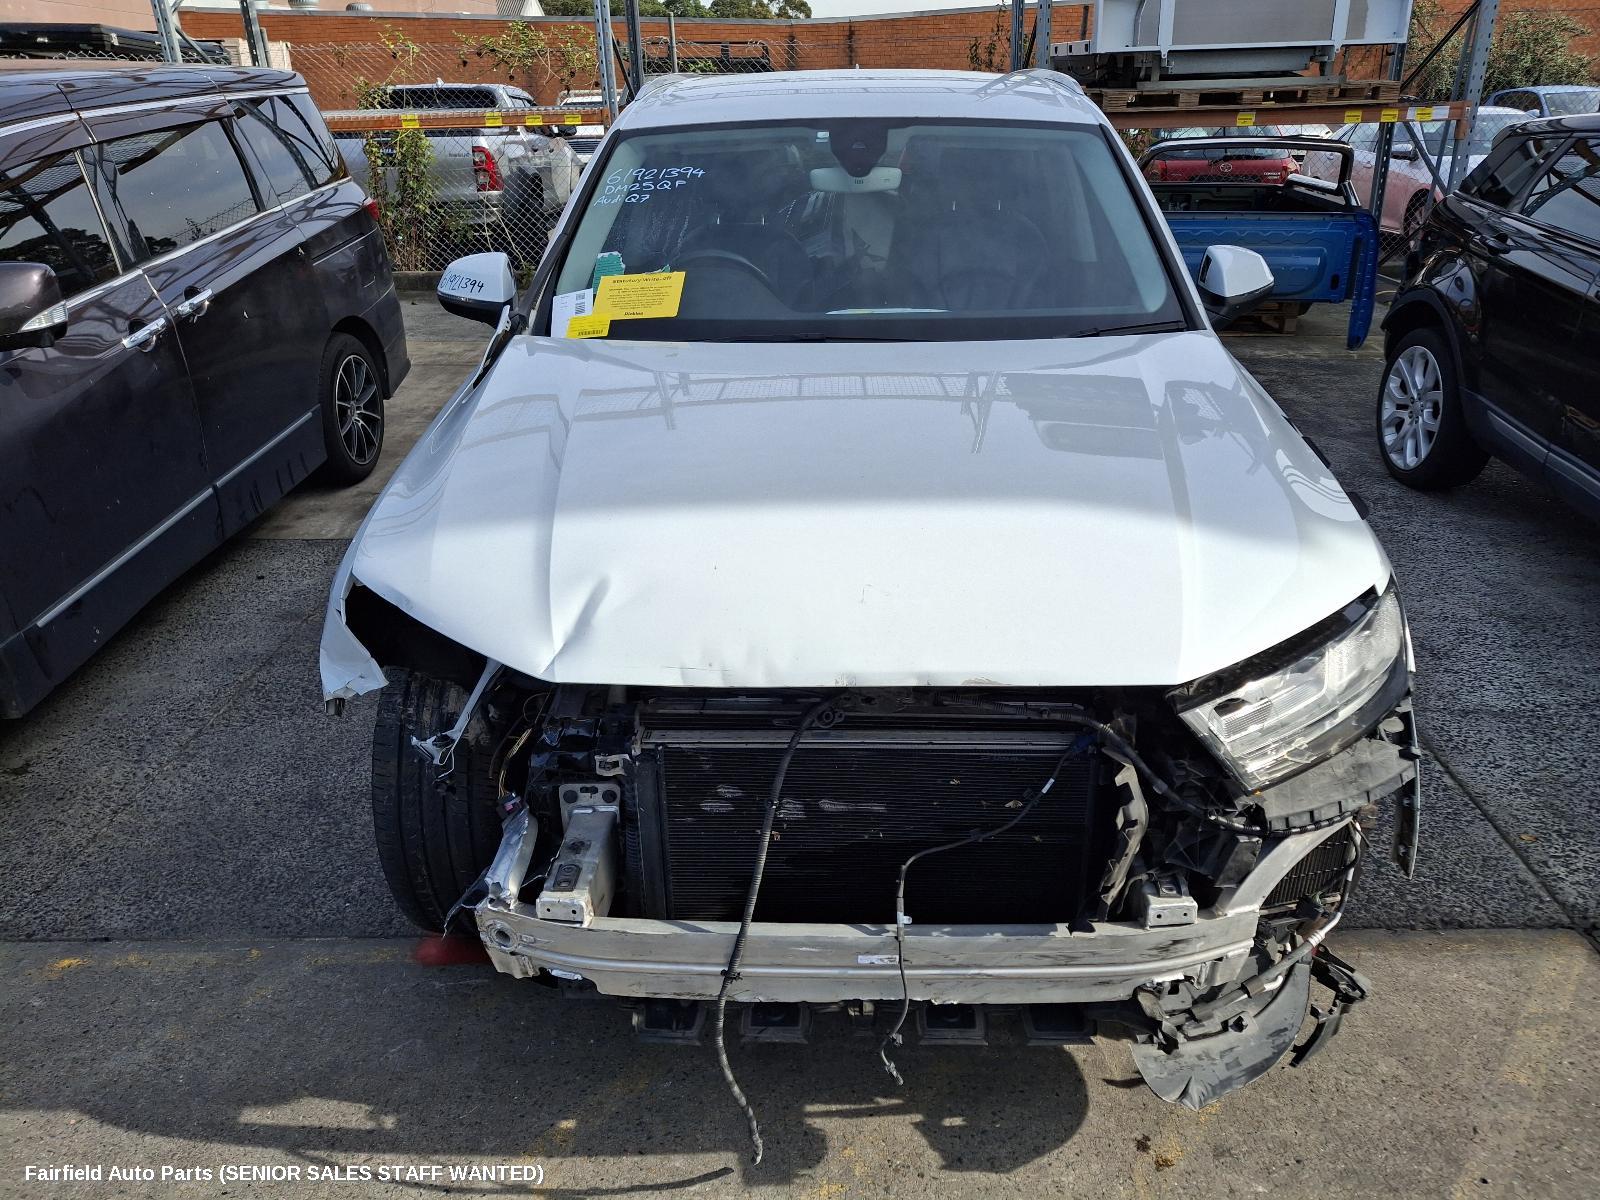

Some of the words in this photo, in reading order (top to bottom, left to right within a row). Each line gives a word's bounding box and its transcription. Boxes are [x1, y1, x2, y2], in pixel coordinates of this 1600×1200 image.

[606, 166, 706, 185] 61921394
[593, 194, 624, 207] Audi
[625, 193, 651, 204] Q7
